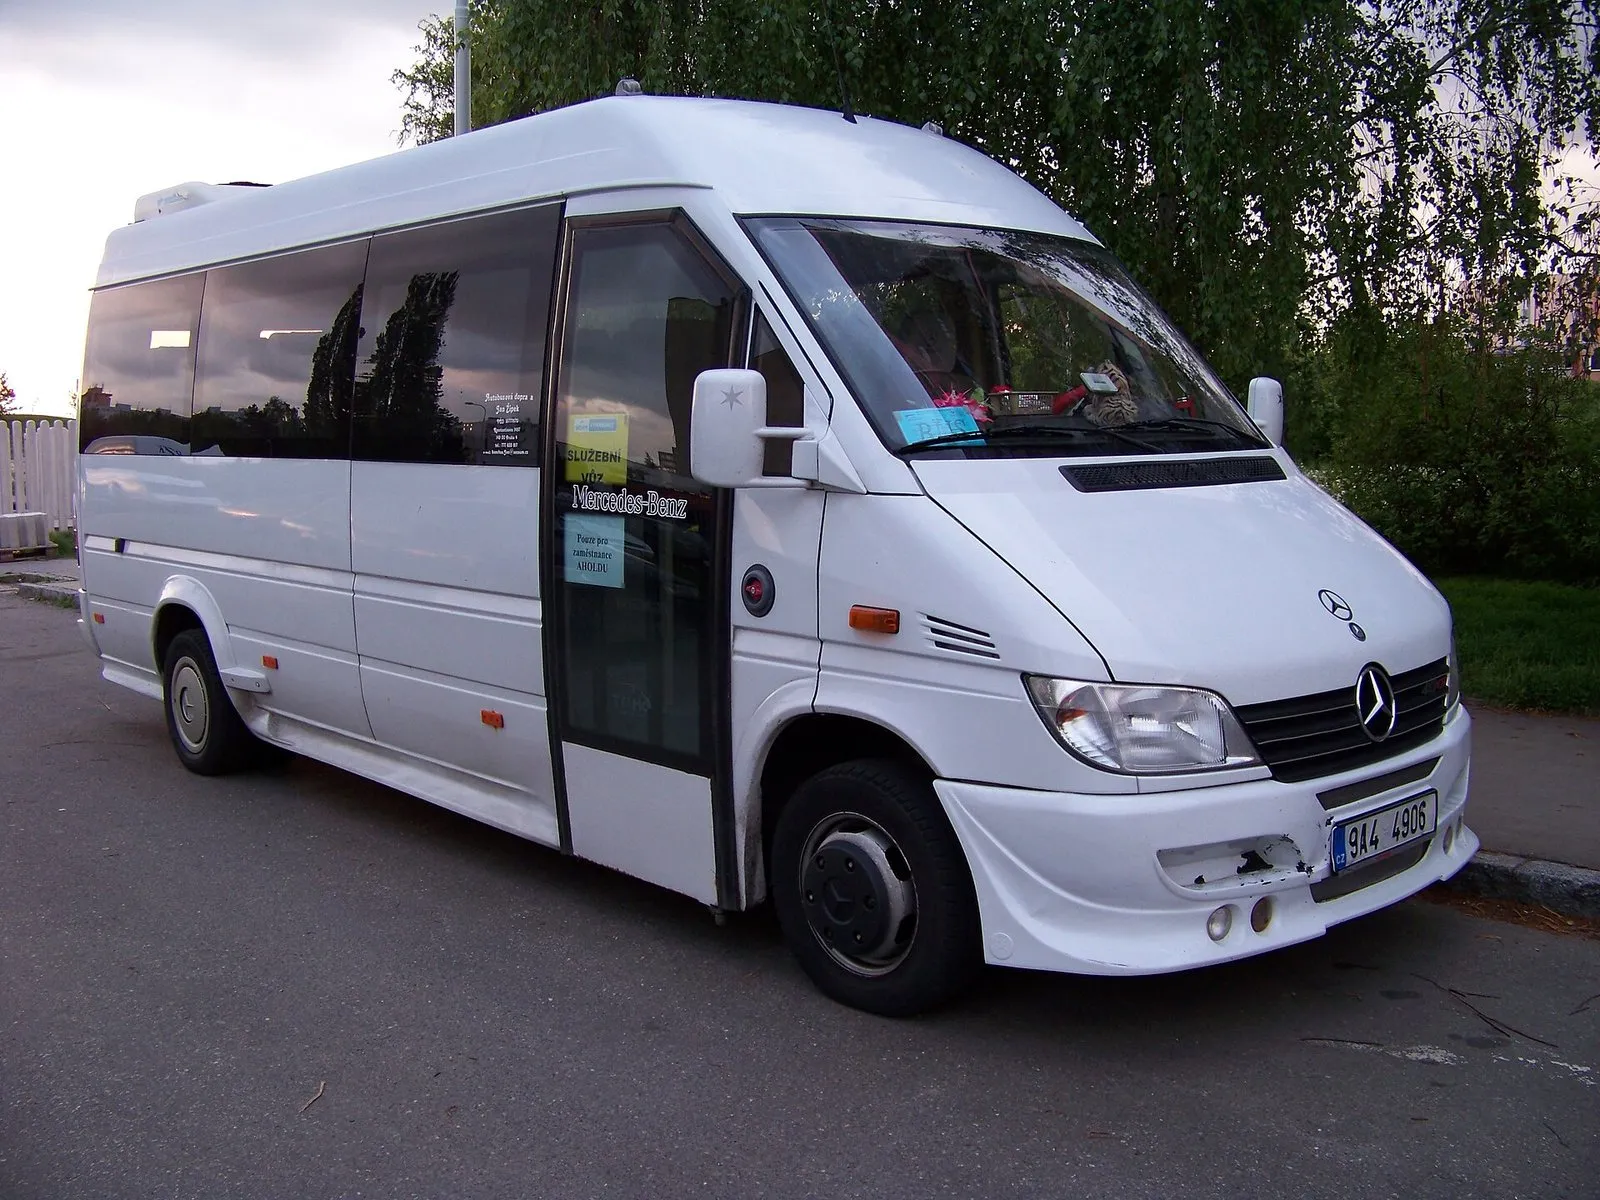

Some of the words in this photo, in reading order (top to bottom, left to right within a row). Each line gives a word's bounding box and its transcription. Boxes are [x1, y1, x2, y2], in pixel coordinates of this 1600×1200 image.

[567, 448, 621, 463] SLUŽEBNÍ
[581, 469, 604, 484] VŮZ
[572, 485, 688, 518] Mercedes-Benz
[577, 533, 596, 544] Pouze
[597, 537, 609, 547] pro
[572, 549, 613, 560] zaměstnance
[576, 562, 608, 573] AHOLDU
[1349, 819, 1379, 859] 9A4
[1392, 801, 1426, 841] 4906
[1336, 853, 1345, 865] CZ
